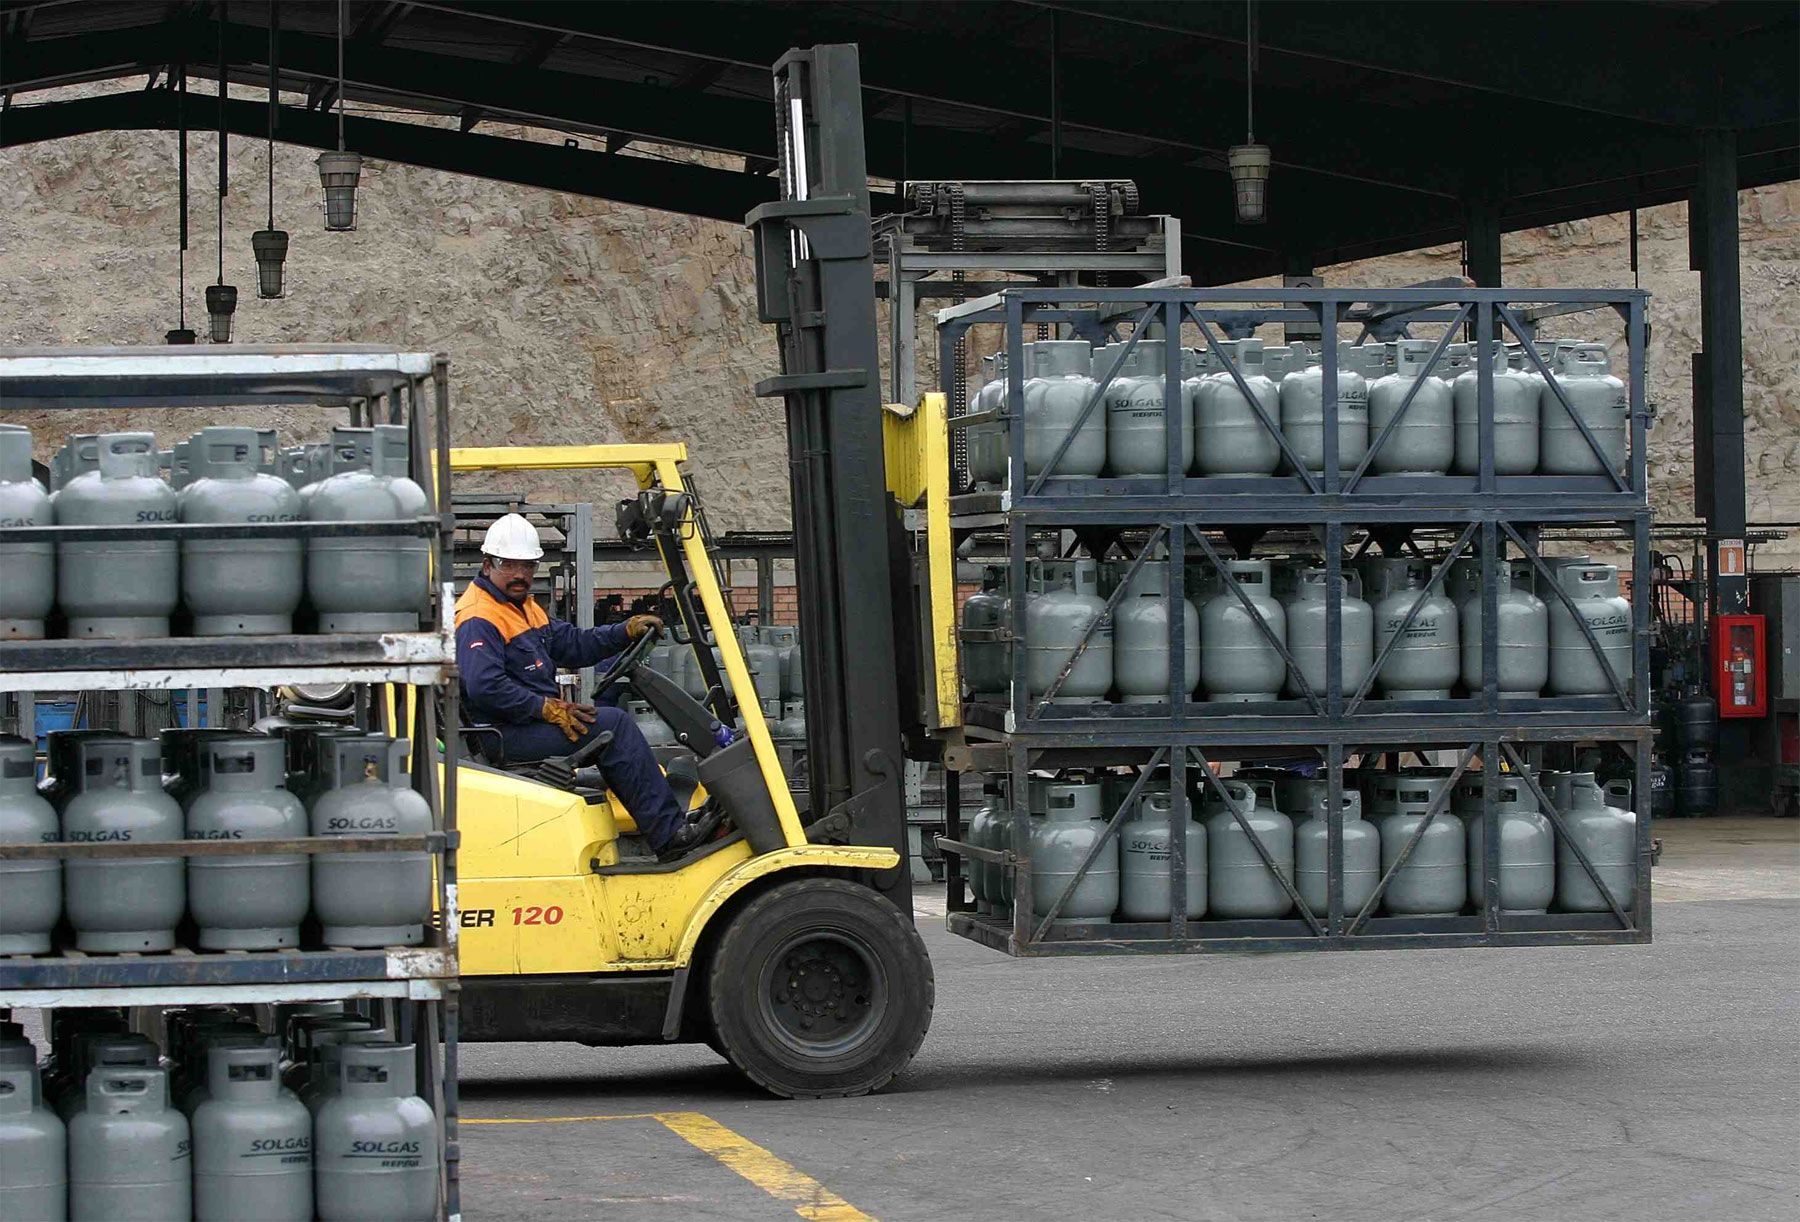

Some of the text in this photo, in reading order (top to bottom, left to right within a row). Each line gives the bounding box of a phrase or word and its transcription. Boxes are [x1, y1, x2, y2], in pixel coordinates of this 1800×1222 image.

[1114, 399, 1163, 408] SOLGAS
[328, 817, 396, 829] SOLGAS
[512, 905, 564, 926] 120
[250, 1137, 310, 1151] SOLGAS
[352, 1140, 420, 1153] SOLGAS
